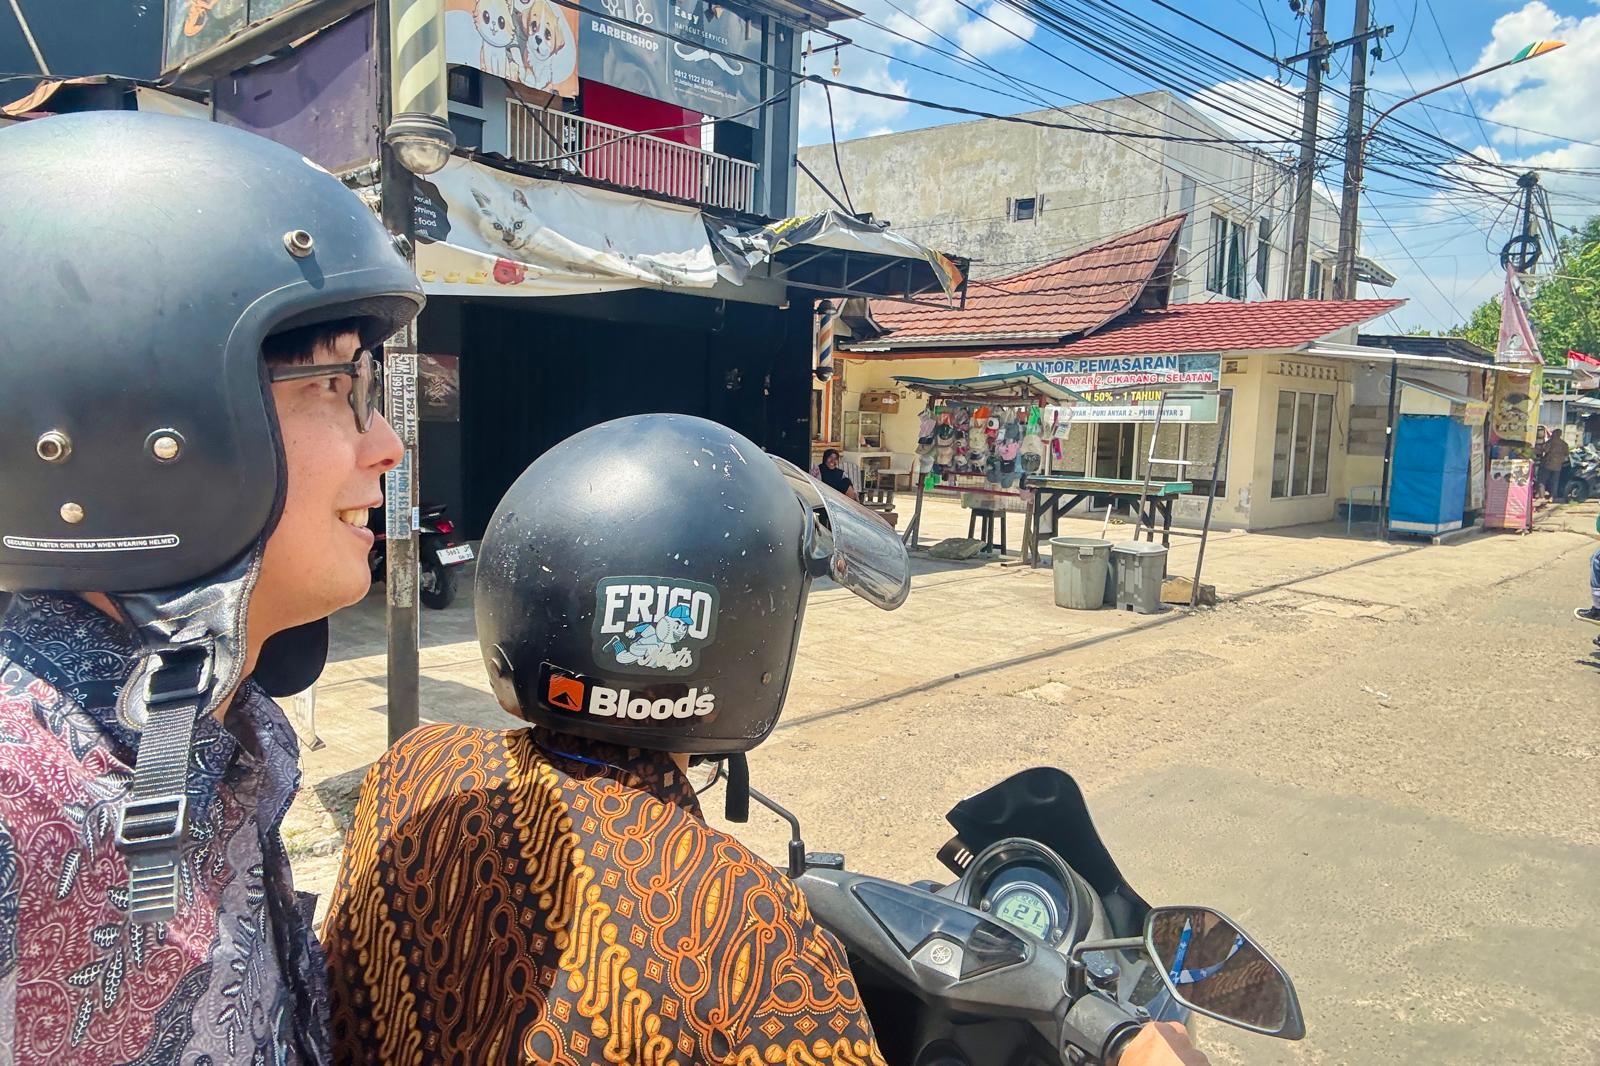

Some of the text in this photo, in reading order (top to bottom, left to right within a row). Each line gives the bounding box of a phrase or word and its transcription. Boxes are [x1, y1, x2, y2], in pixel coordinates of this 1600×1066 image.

[674, 5, 699, 25] Easy
[591, 20, 659, 52] BARBERSHOP
[674, 22, 728, 46] HAIRCUT SERVICES
[418, 217, 437, 227] food
[1015, 355, 1177, 374] KANTOR PEMASARAN
[405, 376, 414, 394] 119
[1062, 376, 1093, 386] ANYAR
[1107, 373, 1158, 384] CIKARANG
[1166, 371, 1212, 383] SELATAN
[1094, 391, 1113, 402] 50%
[1131, 389, 1162, 401] TAHUN
[392, 398, 404, 418] 7777
[406, 397, 415, 415] 264
[1107, 409, 1127, 417] ANYAR
[1139, 408, 1155, 417] PURI
[1162, 408, 1178, 416] NYAR
[97, 541, 116, 549] WHEN
[117, 540, 148, 548] WEARING
[149, 537, 176, 546] HELMET
[1013, 904, 1042, 925] 21
